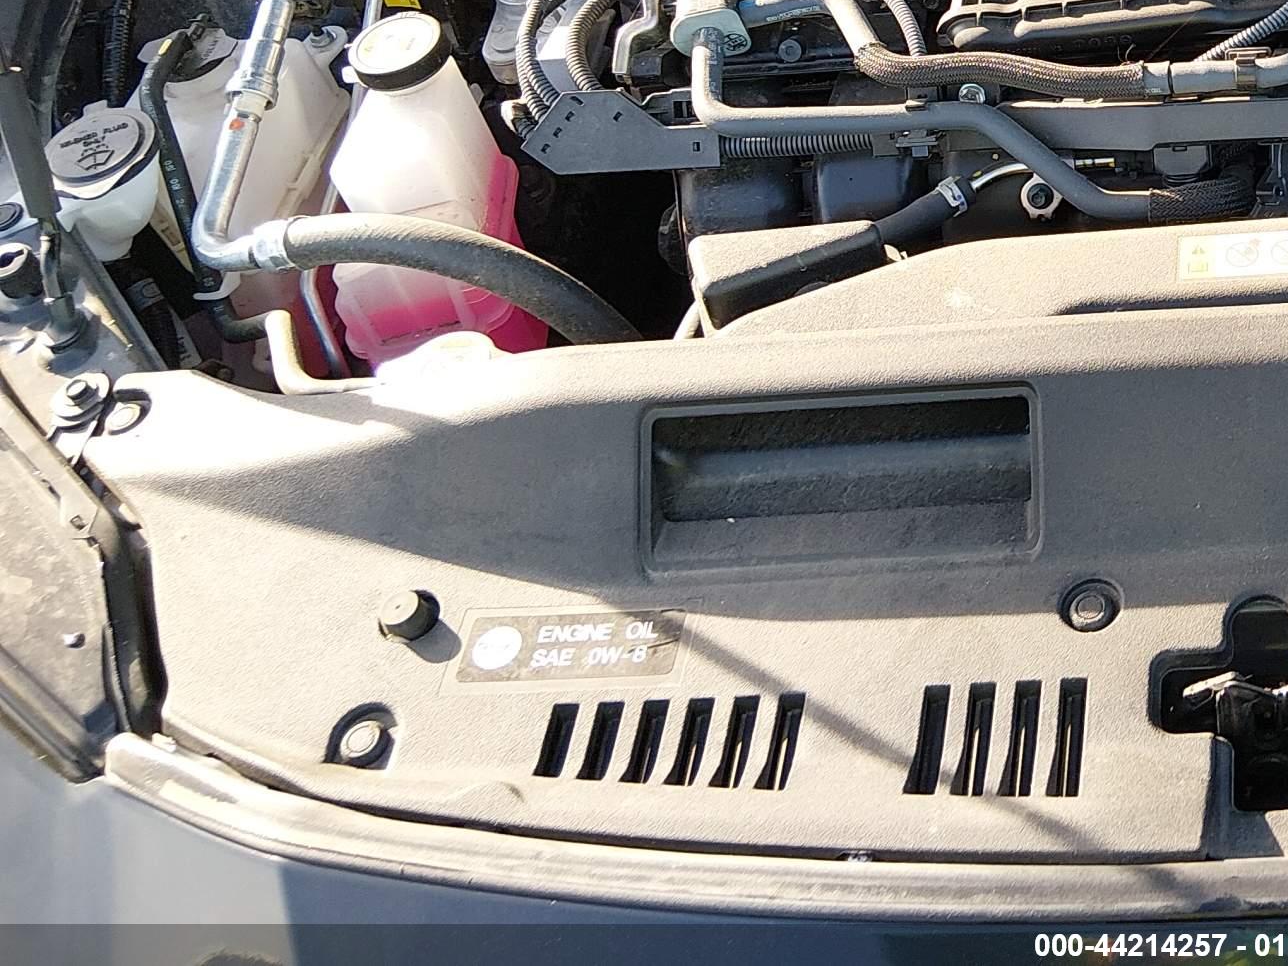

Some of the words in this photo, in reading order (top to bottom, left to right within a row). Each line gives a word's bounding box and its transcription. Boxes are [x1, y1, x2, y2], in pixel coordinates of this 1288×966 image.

[537, 623, 614, 643] ENGINE
[625, 621, 658, 639] OIL
[531, 648, 575, 667] SAE
